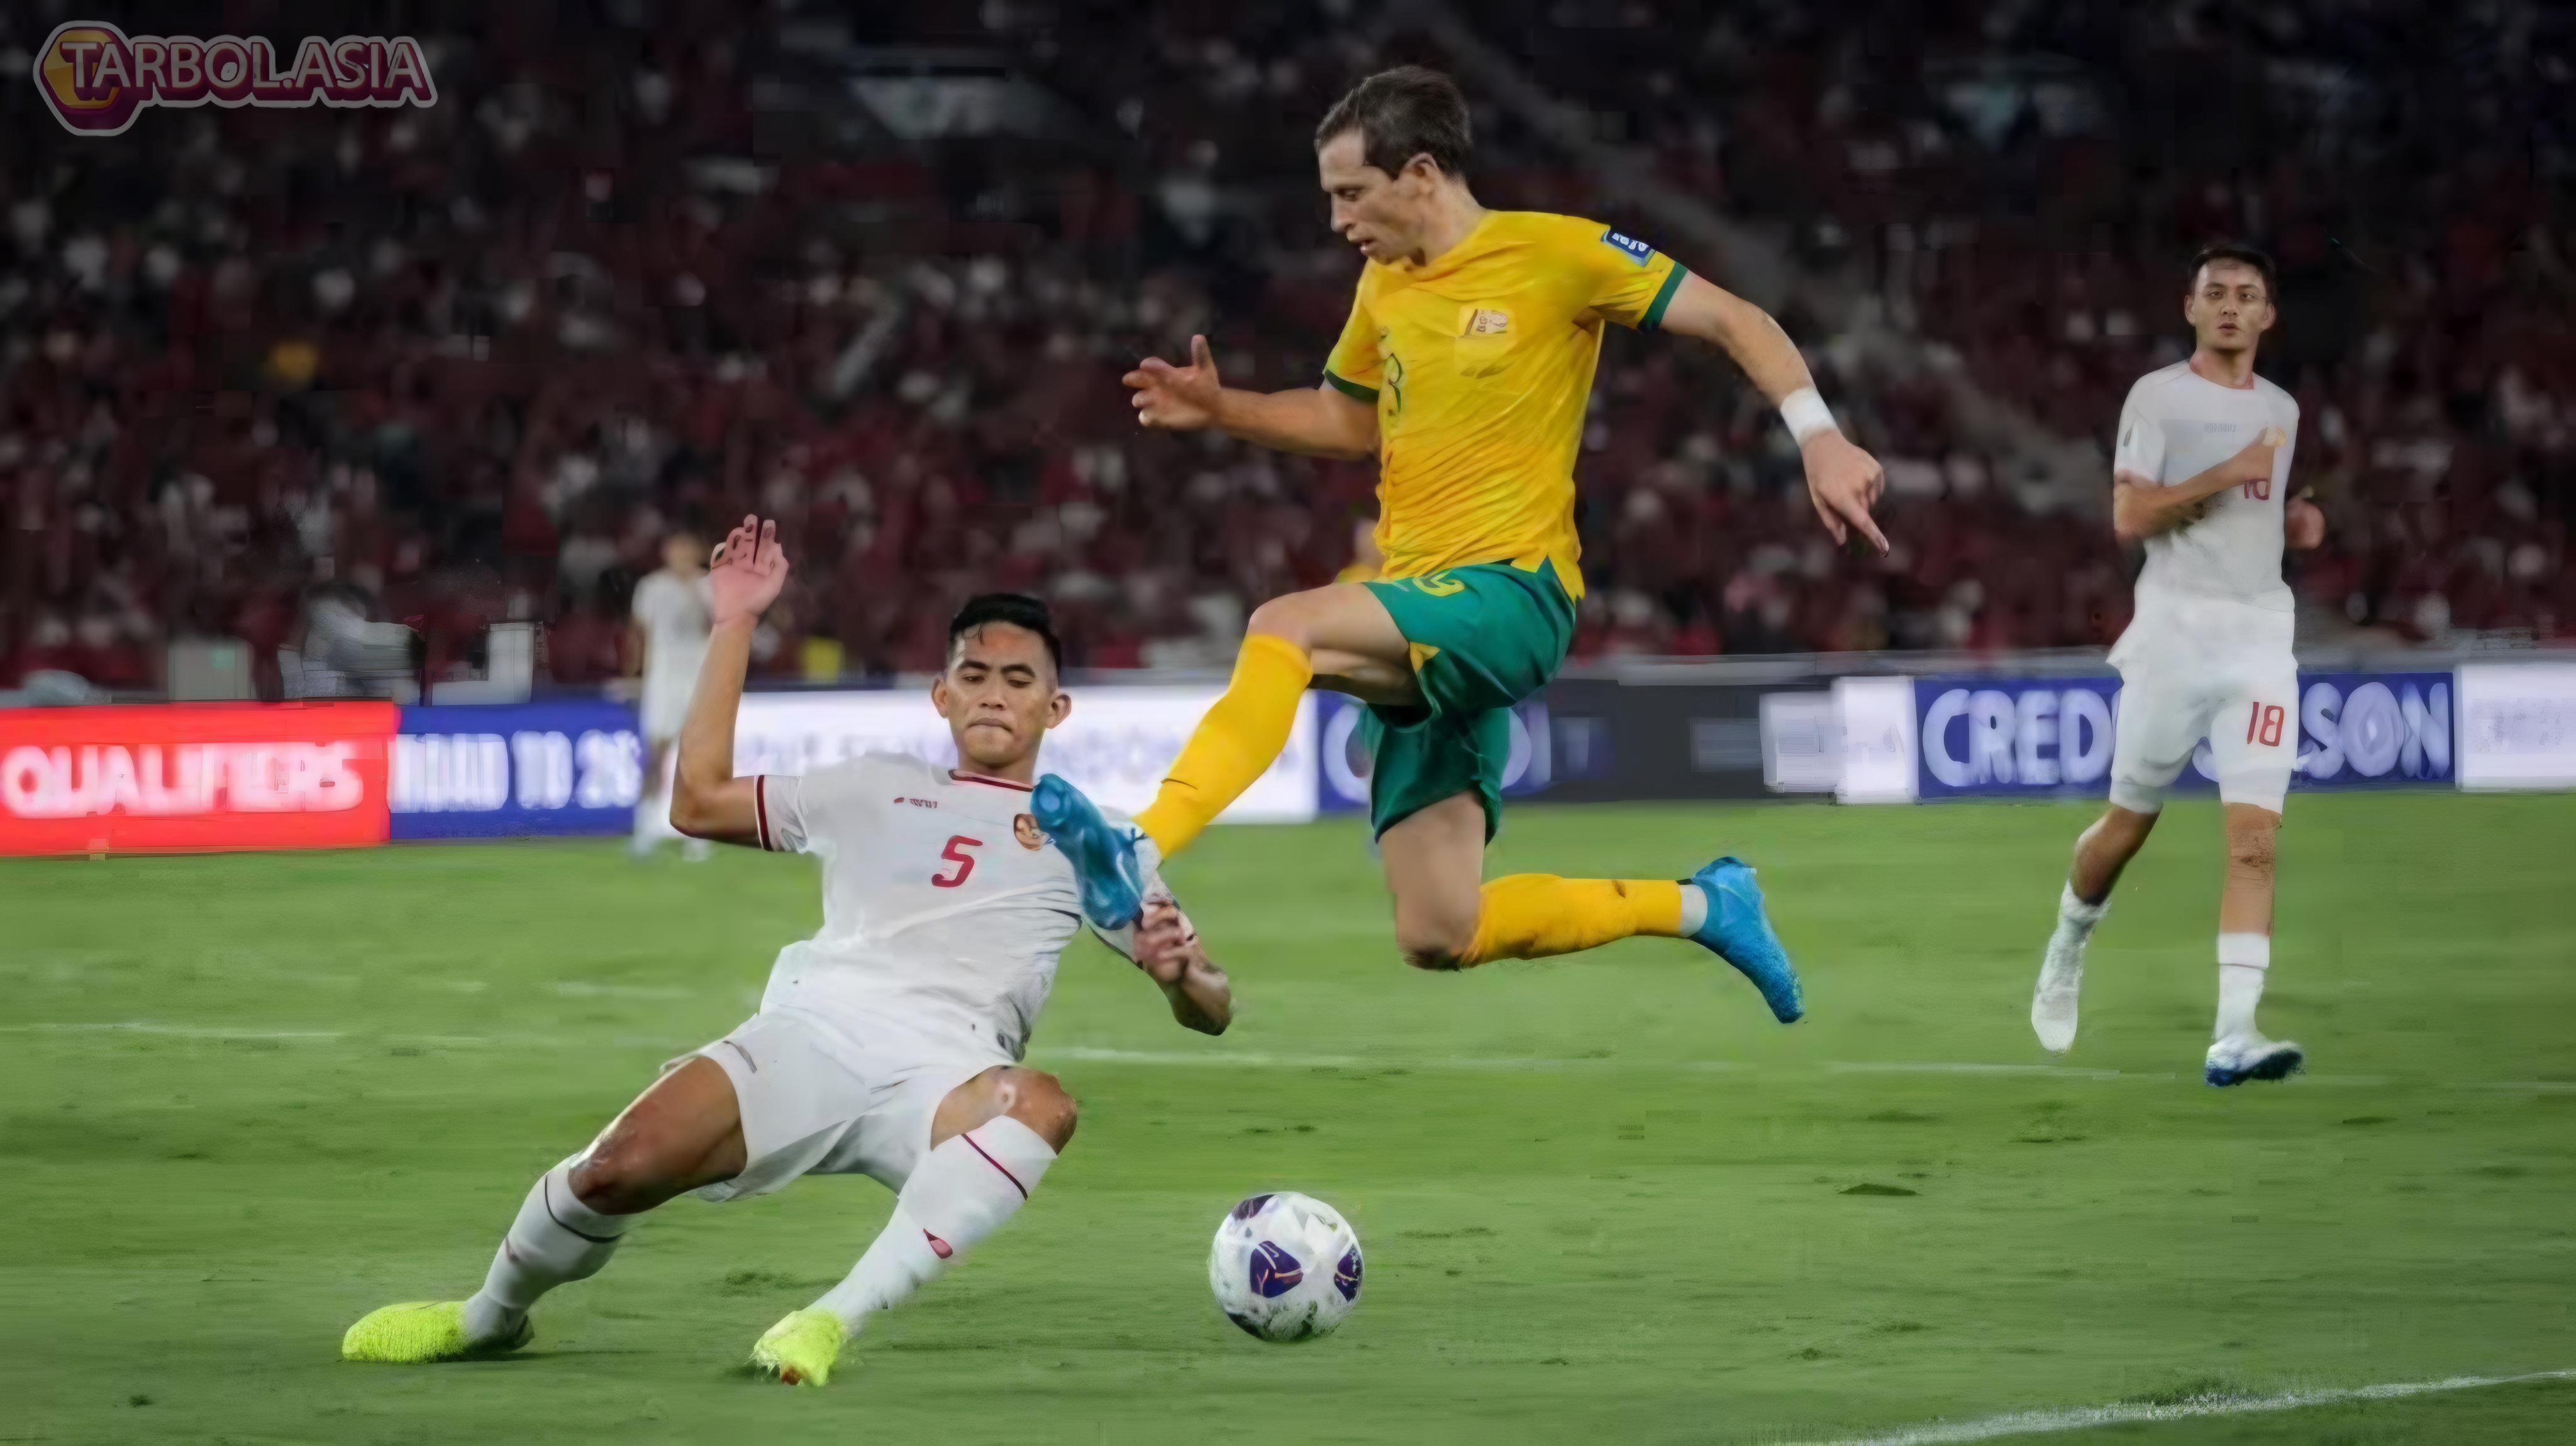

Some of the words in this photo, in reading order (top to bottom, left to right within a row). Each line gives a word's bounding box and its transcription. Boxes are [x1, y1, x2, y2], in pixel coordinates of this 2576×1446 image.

[1923, 687, 2121, 787] CRED
[2247, 701, 2284, 747] 18
[931, 835, 983, 887] 5
